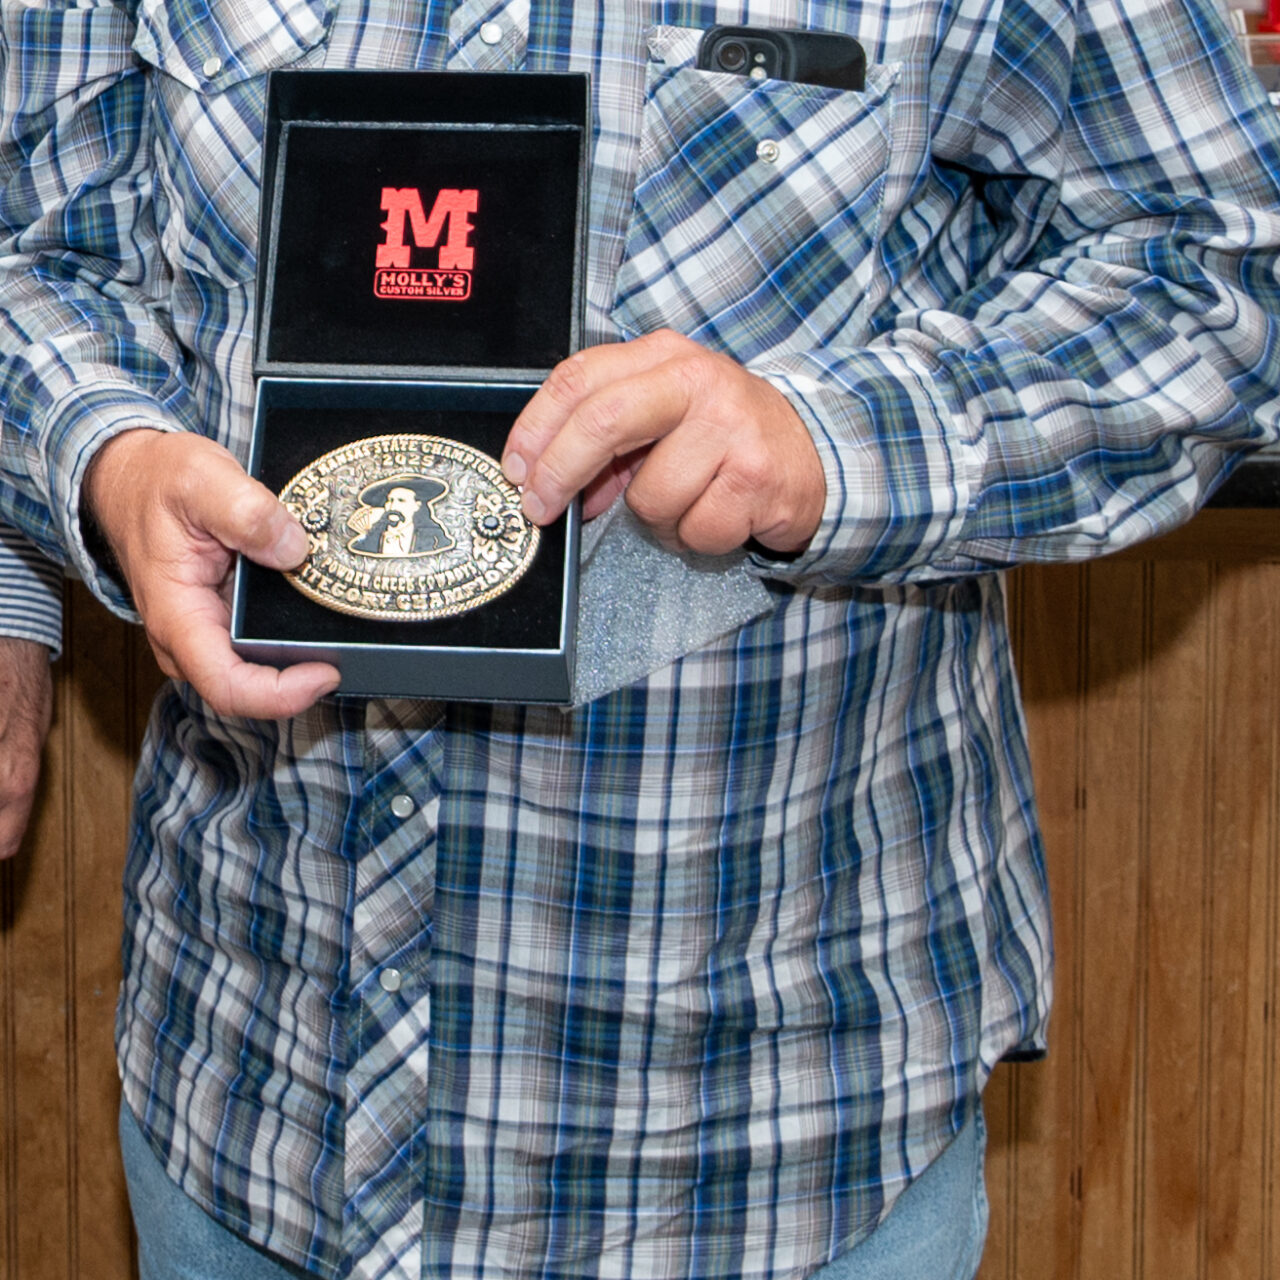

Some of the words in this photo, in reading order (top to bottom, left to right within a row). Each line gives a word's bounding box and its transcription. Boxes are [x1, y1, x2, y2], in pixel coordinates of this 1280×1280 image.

[375, 187, 480, 270] M
[379, 285, 424, 295] CUSTOM
[426, 286, 465, 297] SILVER
[380, 272, 466, 287] MOLLY'S
[292, 471, 321, 496] THE
[318, 444, 371, 477] KANSAS
[373, 439, 418, 454] STATE
[382, 453, 435, 468] 2025
[321, 556, 371, 587] POWDER
[373, 576, 415, 593] CREEK
[418, 561, 478, 591] COWBOYS
[396, 556, 515, 611] CHAMPION
